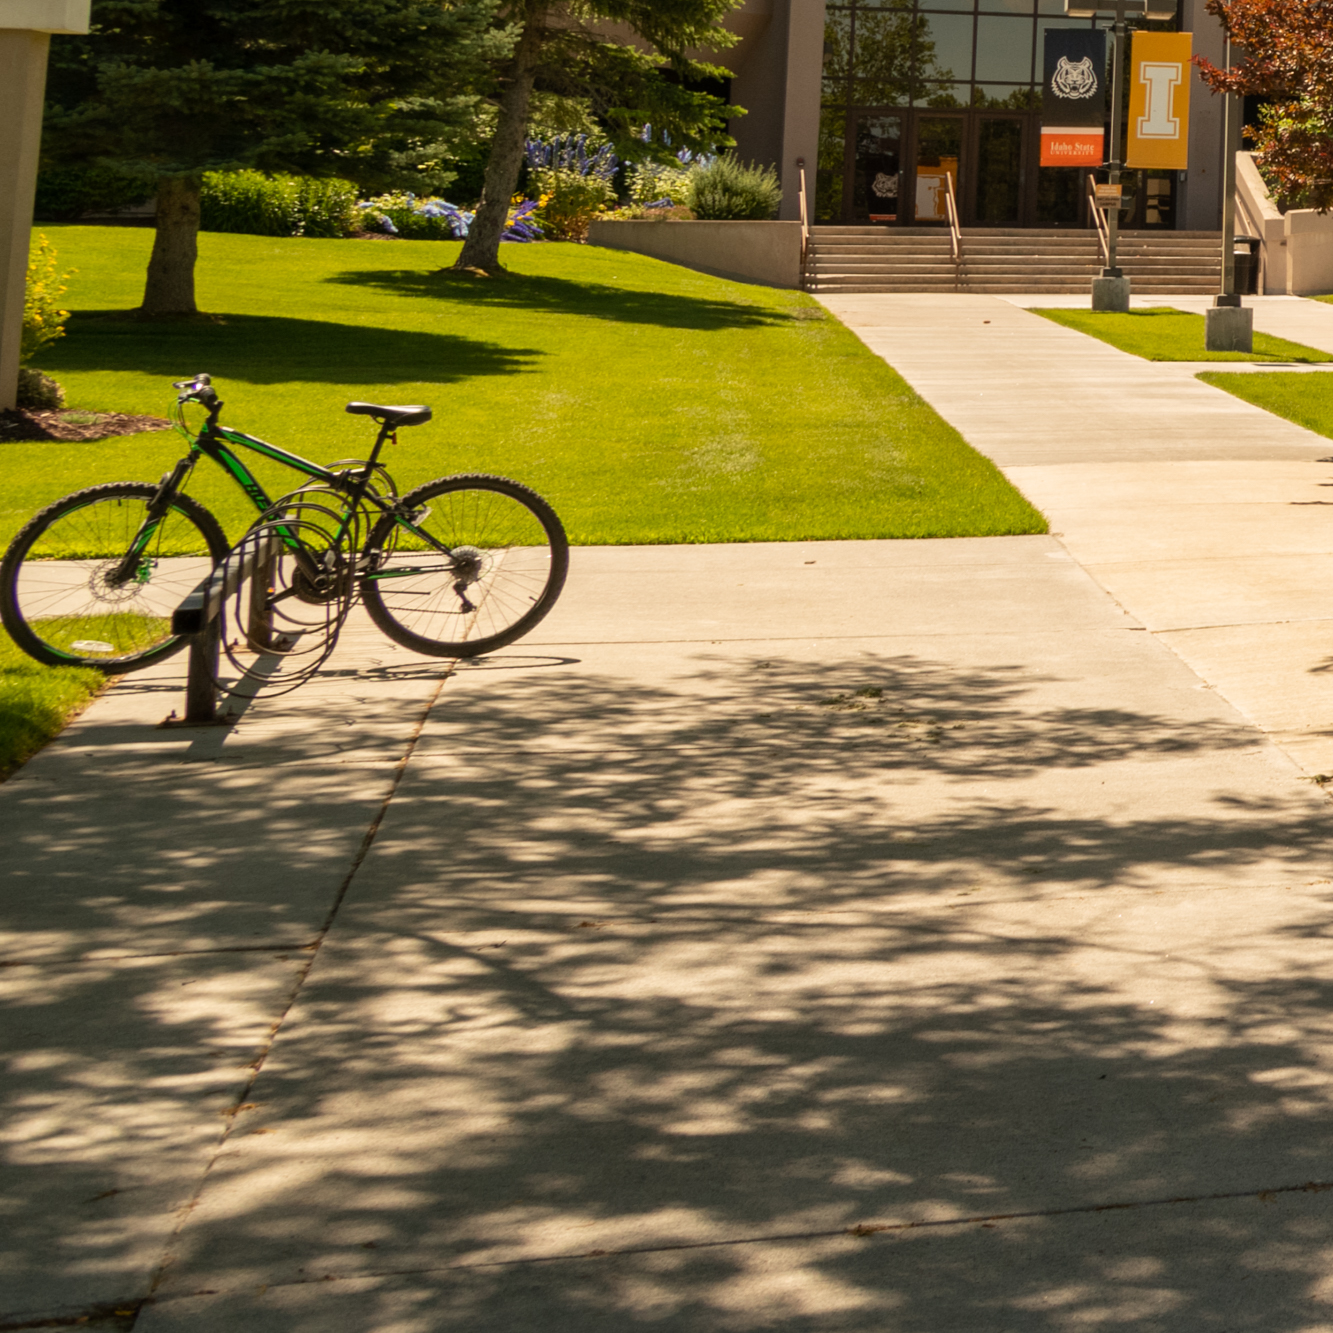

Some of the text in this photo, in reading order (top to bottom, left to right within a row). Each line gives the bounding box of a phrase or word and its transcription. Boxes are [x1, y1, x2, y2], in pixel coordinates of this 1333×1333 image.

[1137, 61, 1182, 139] I
[1050, 141, 1095, 151] Idaho State
